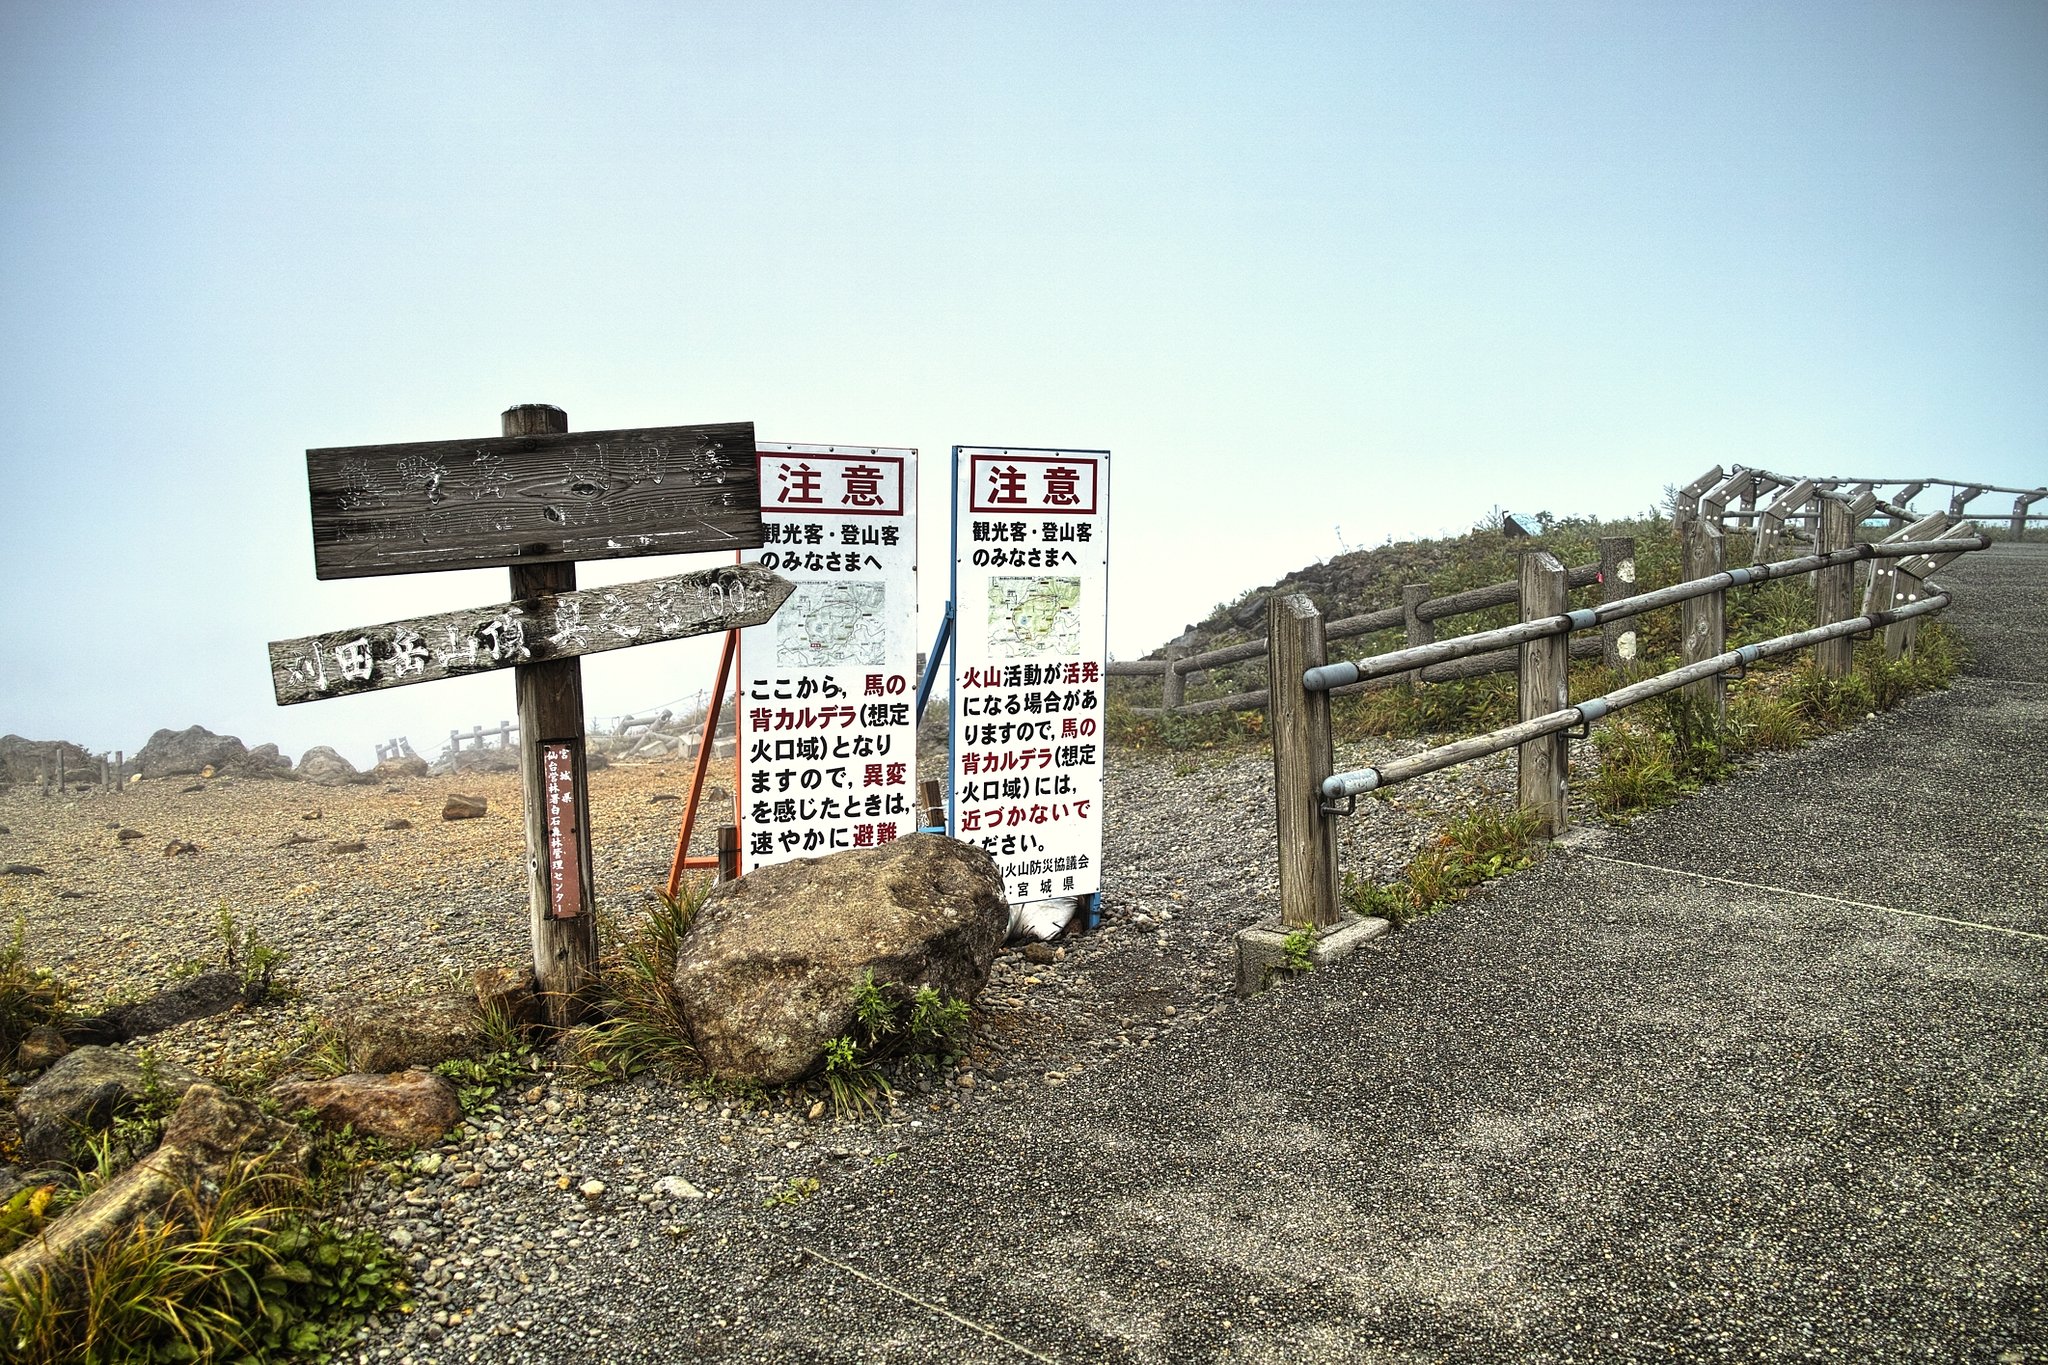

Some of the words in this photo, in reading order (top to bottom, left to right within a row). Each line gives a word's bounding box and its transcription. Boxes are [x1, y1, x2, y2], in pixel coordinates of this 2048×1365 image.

[777, 463, 885, 506] 注意
[987, 465, 1080, 505] 注意
[762, 523, 900, 546] 観光客・登山客
[972, 521, 1093, 542] 観光客・登山客
[760, 551, 882, 572] のみなさまへ
[972, 548, 1077, 567] のみなさまへ
[962, 661, 1099, 689] 火山活動が活発
[963, 689, 1098, 717] になる場合があ
[558, 749, 573, 804] 宮城県
[961, 799, 1091, 832] 近づかないで
[750, 822, 897, 856] 速やかに避難
[968, 834, 1044, 856] ださい。
